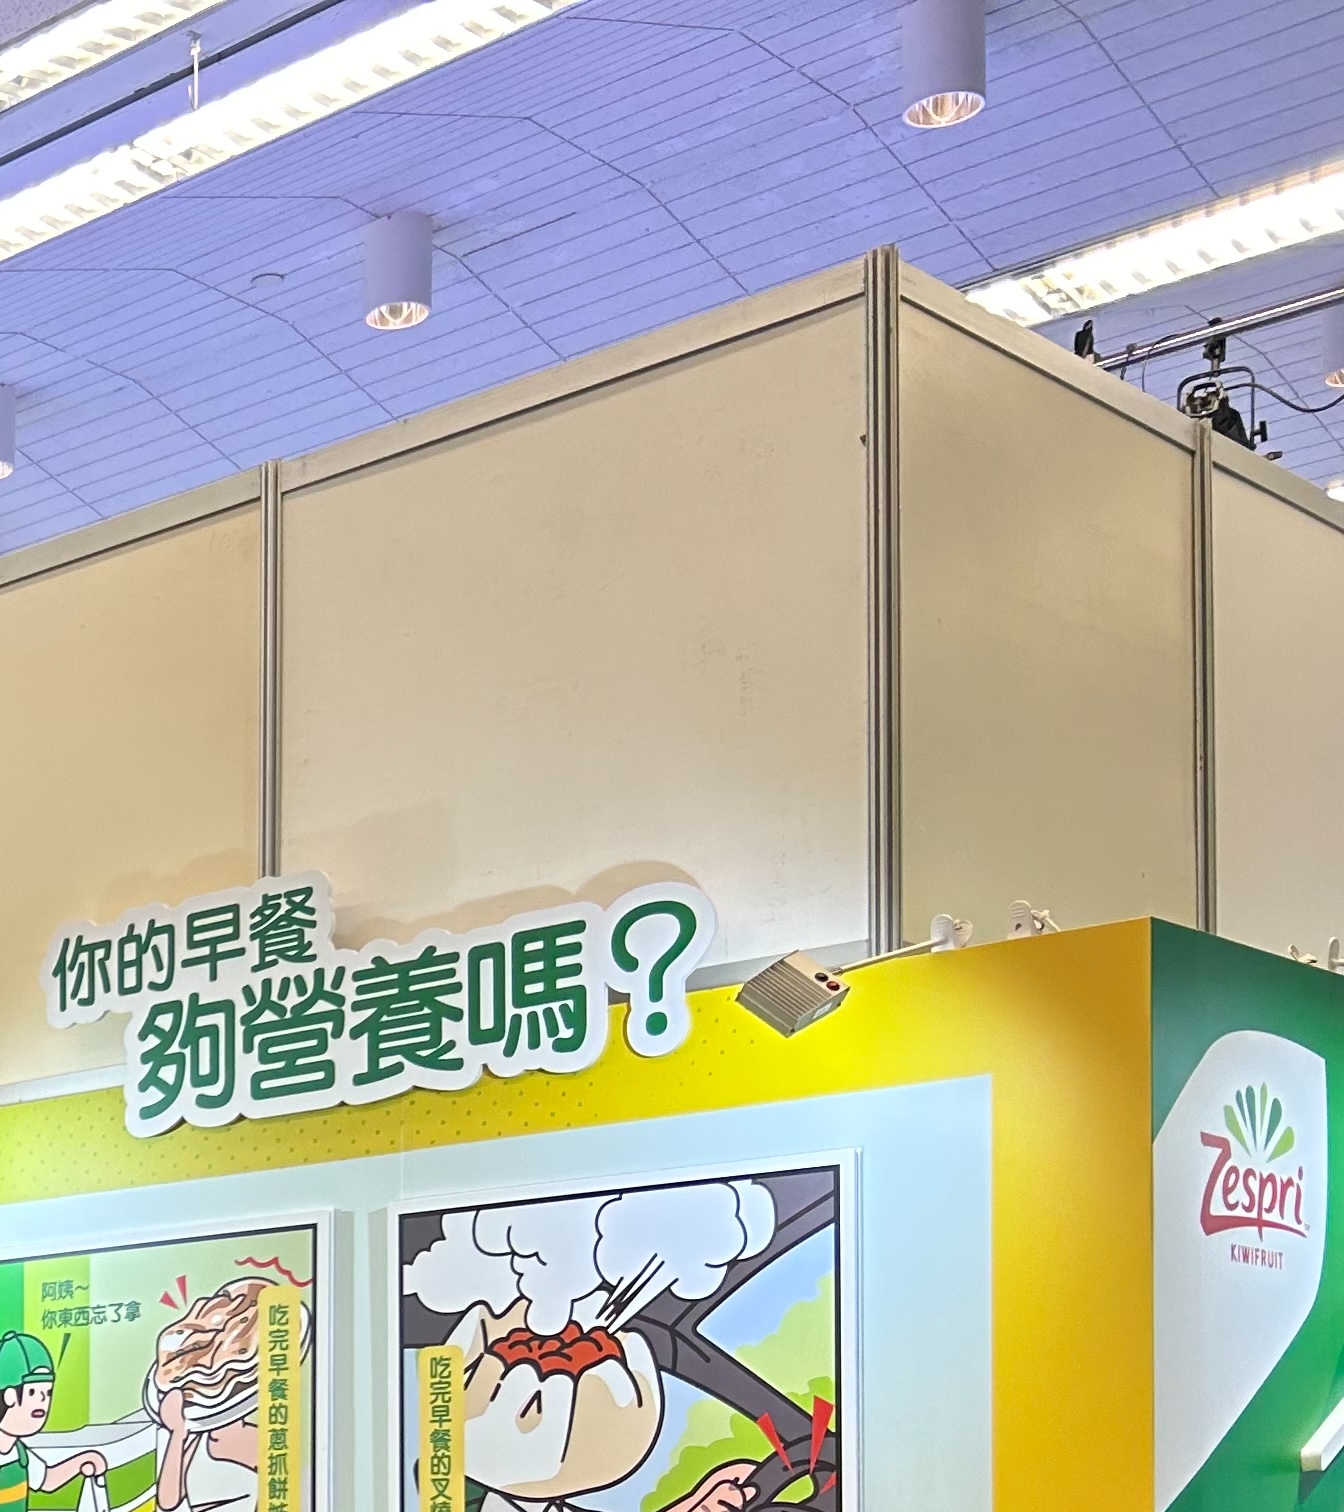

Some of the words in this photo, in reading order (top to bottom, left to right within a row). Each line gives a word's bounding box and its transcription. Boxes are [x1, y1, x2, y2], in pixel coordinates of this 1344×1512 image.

[52, 886, 317, 1008] 你的早餐
[137, 900, 698, 1121] 夠營養嗎?
[1200, 1131, 1308, 1243] Zespri
[1231, 1243, 1283, 1270] KIWIFRUIT
[41, 1301, 141, 1330] 你東西忘了拿
